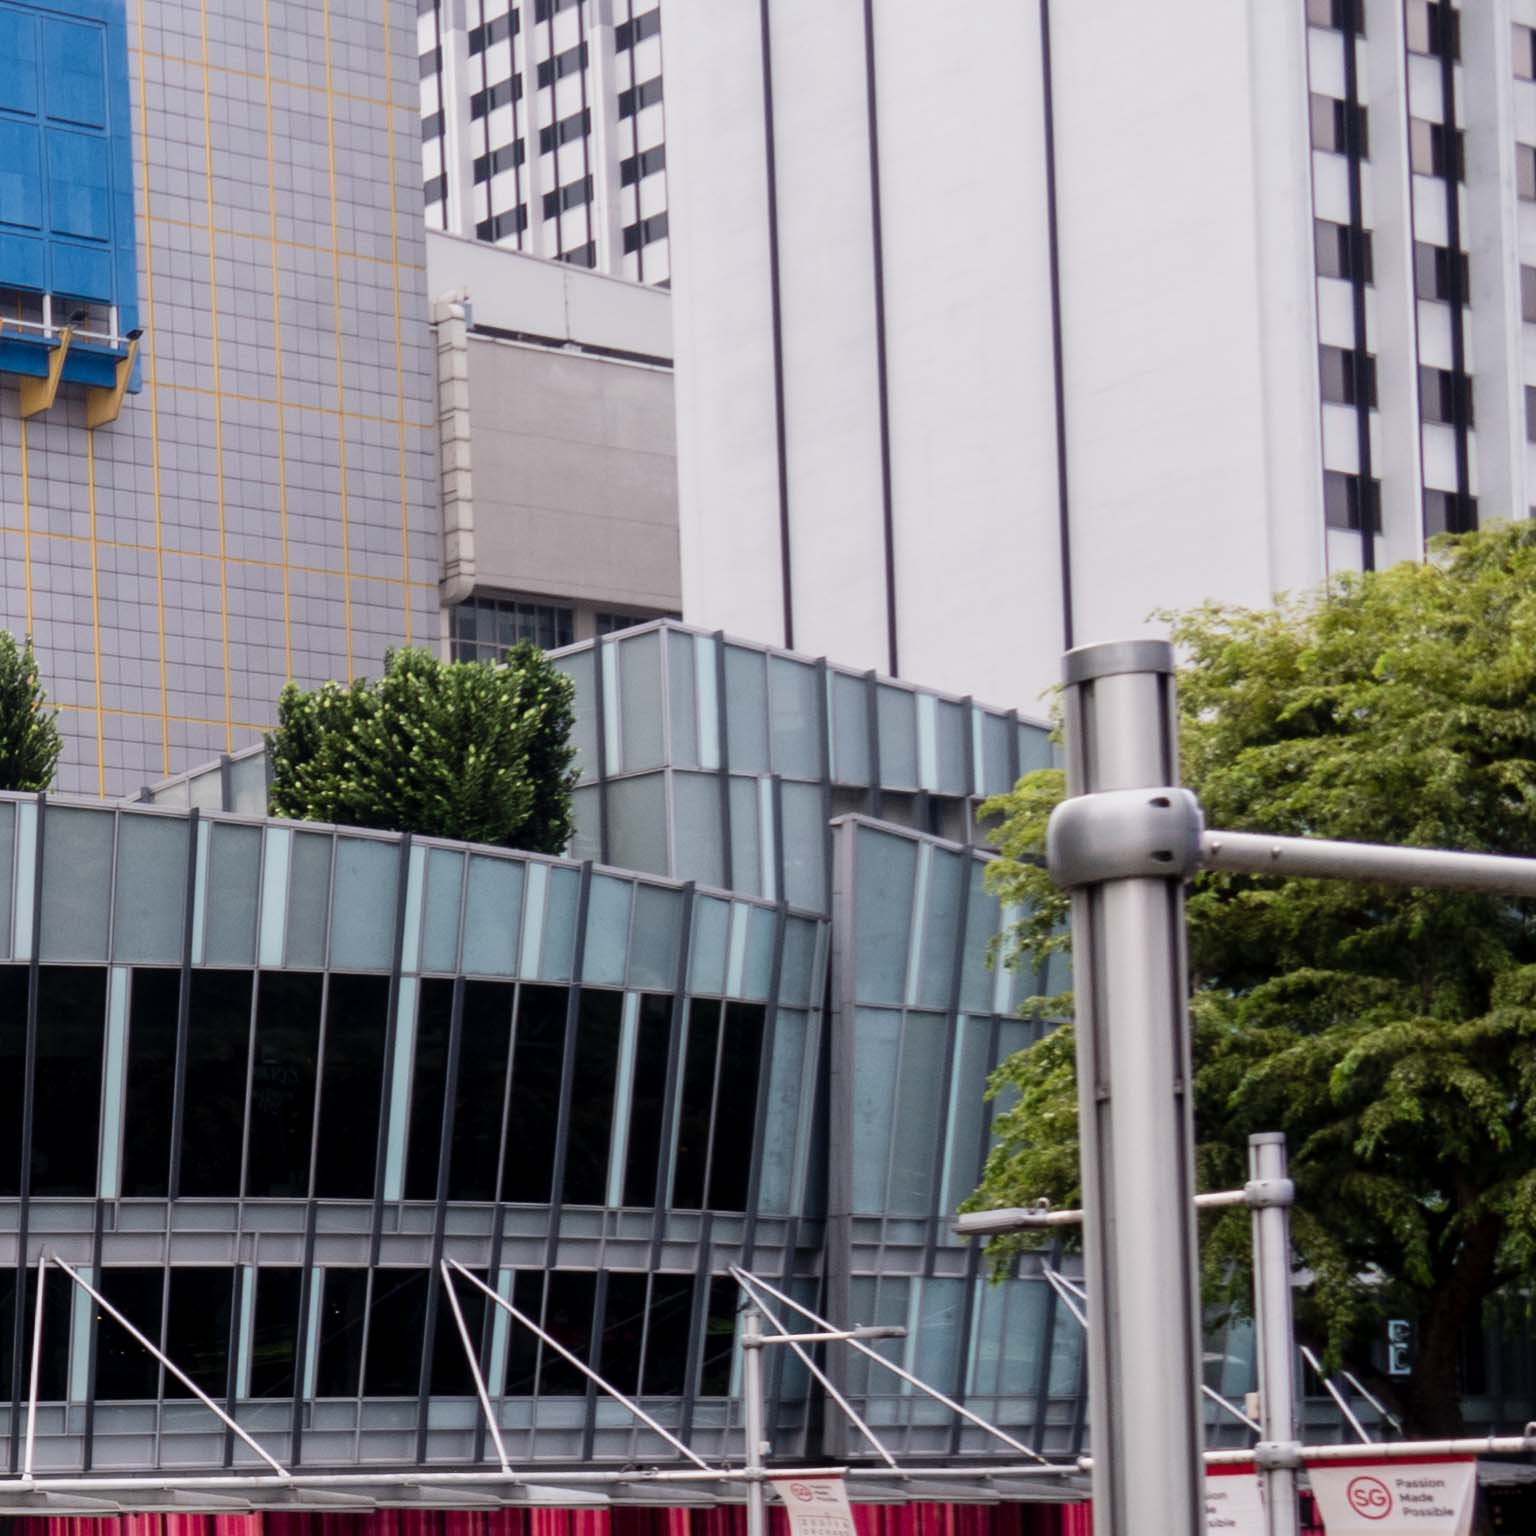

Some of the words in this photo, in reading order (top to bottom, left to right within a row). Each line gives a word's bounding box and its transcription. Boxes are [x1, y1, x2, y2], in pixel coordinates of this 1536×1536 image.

[1354, 1488, 1387, 1506] SG
[1395, 1478, 1445, 1488] Passion
[1399, 1493, 1434, 1502] Made
[1403, 1507, 1455, 1517] Possible
